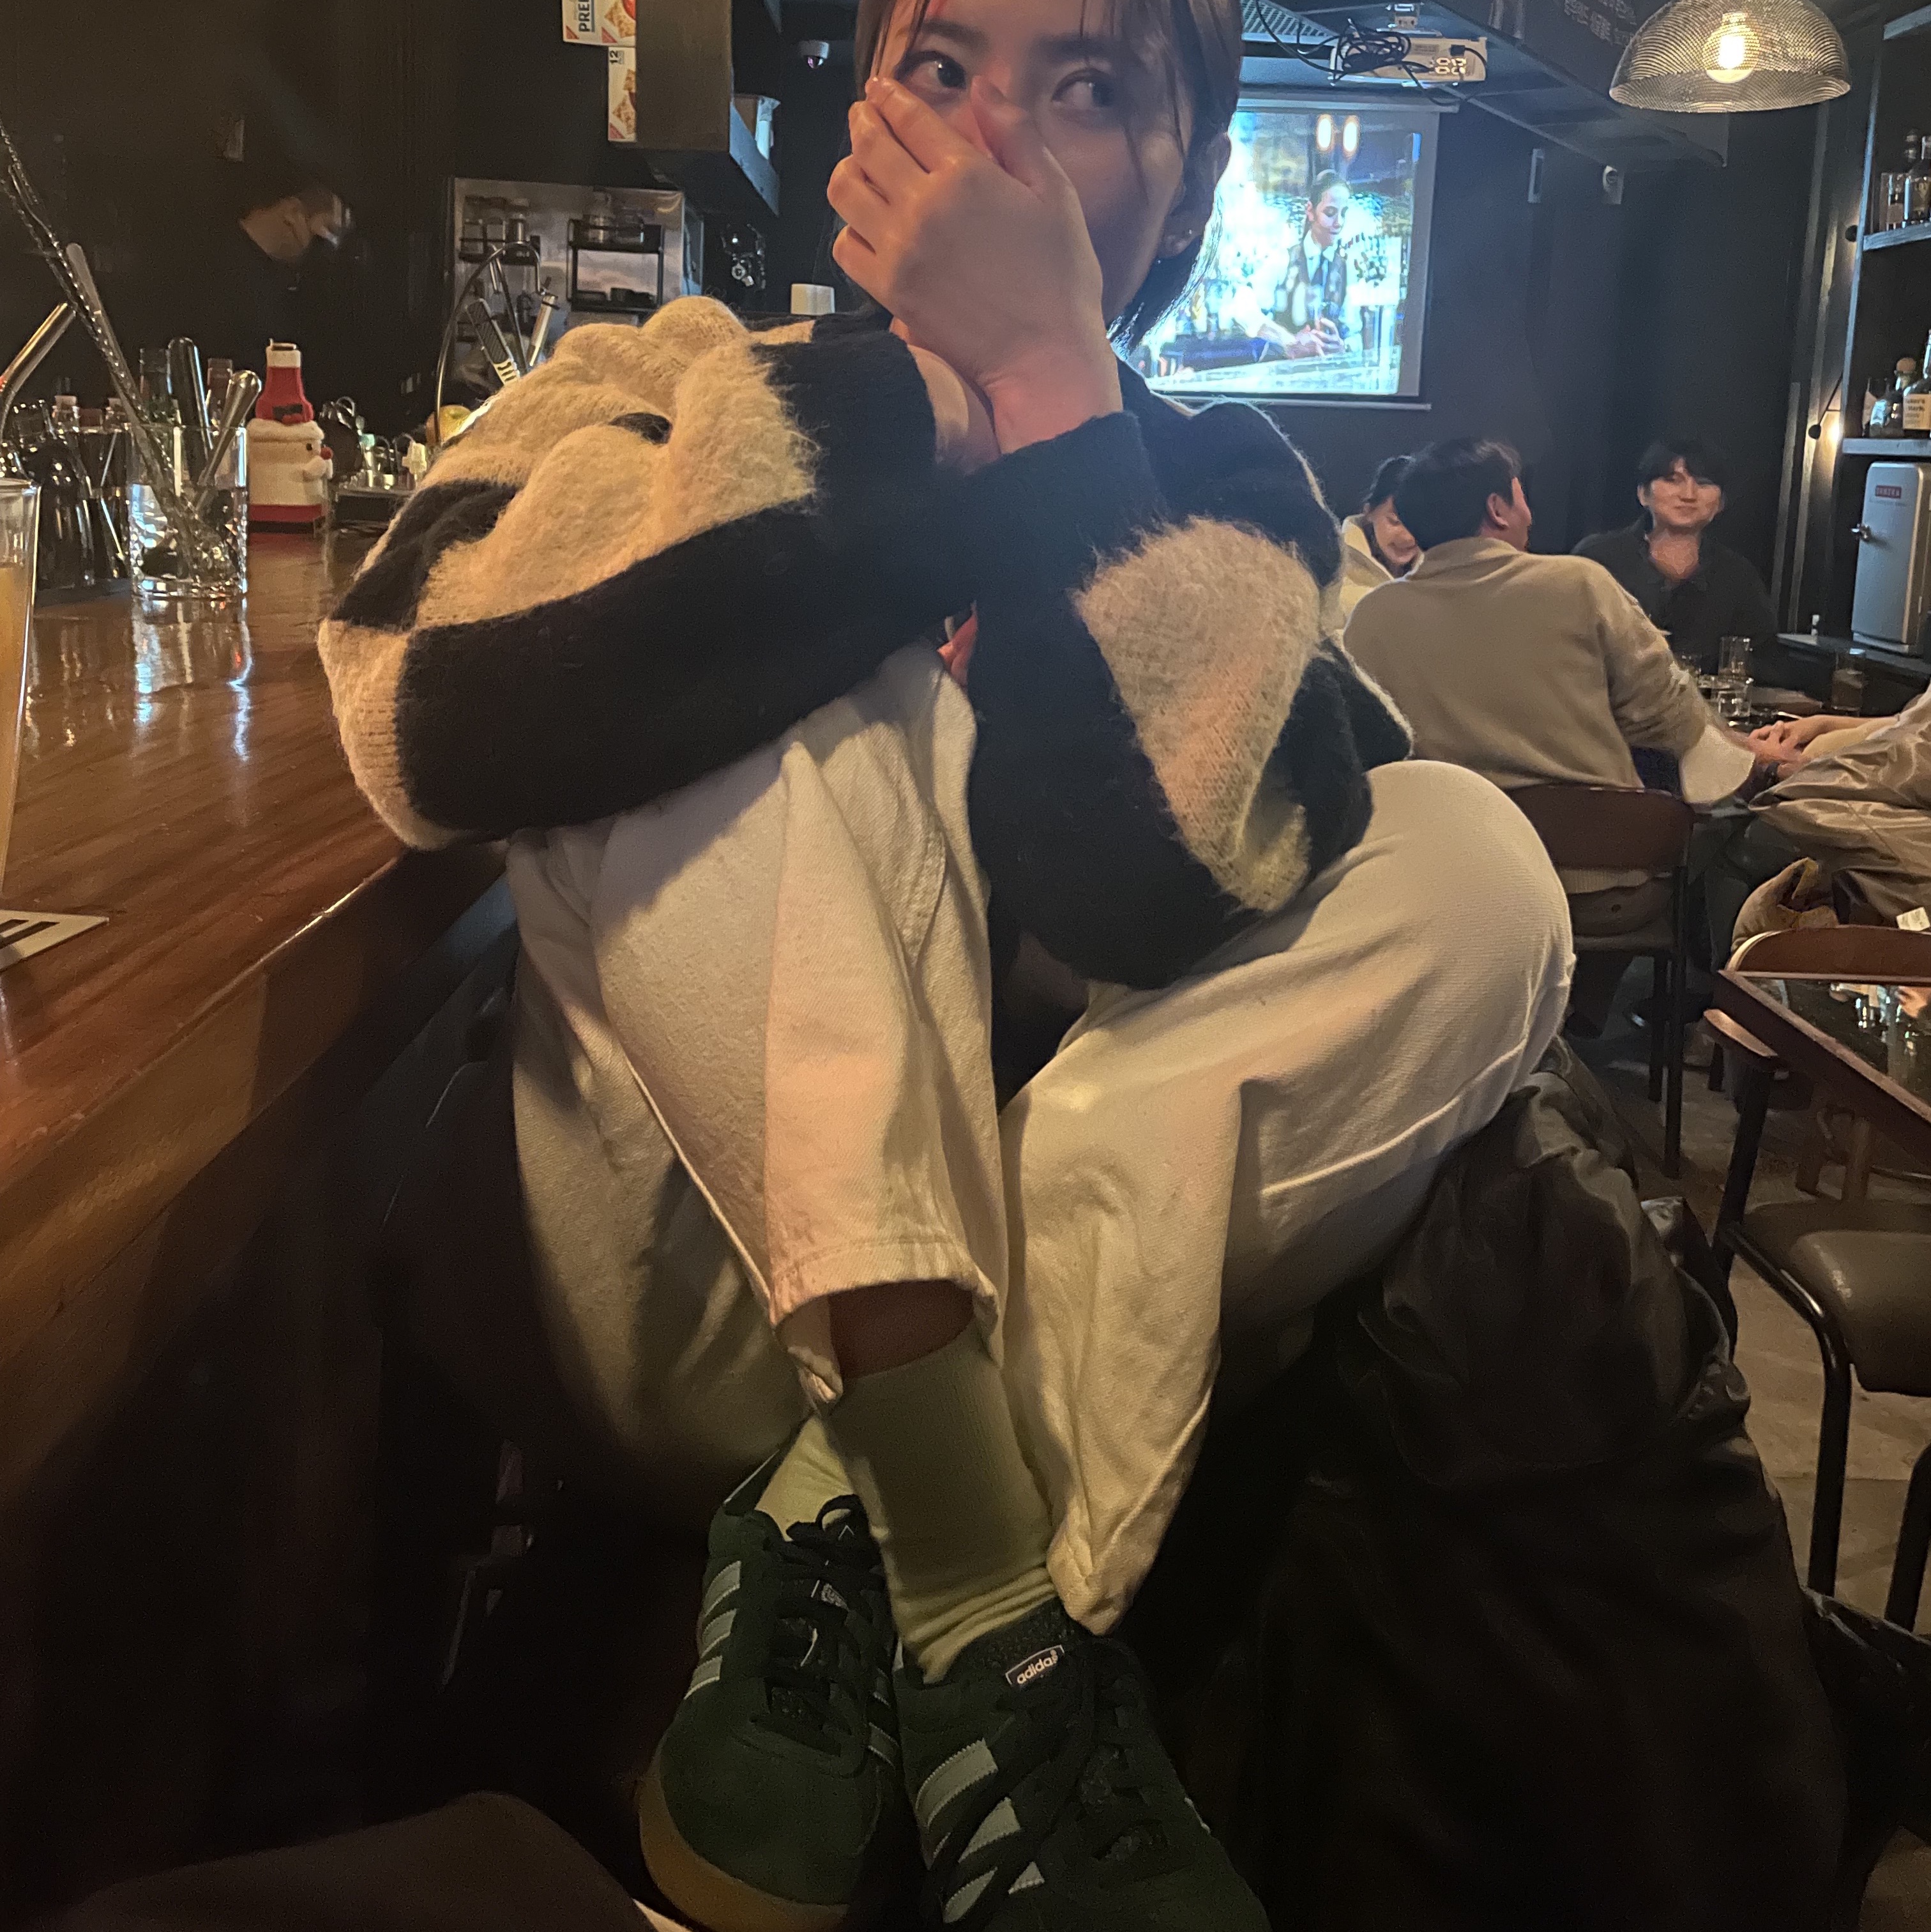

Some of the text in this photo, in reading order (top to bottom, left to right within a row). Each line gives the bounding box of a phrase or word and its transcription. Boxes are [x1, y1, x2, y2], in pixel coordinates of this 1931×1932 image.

[578, 0, 590, 32] PRE
[610, 50, 618, 65] 12
[1017, 1654, 1058, 1684] adidas
